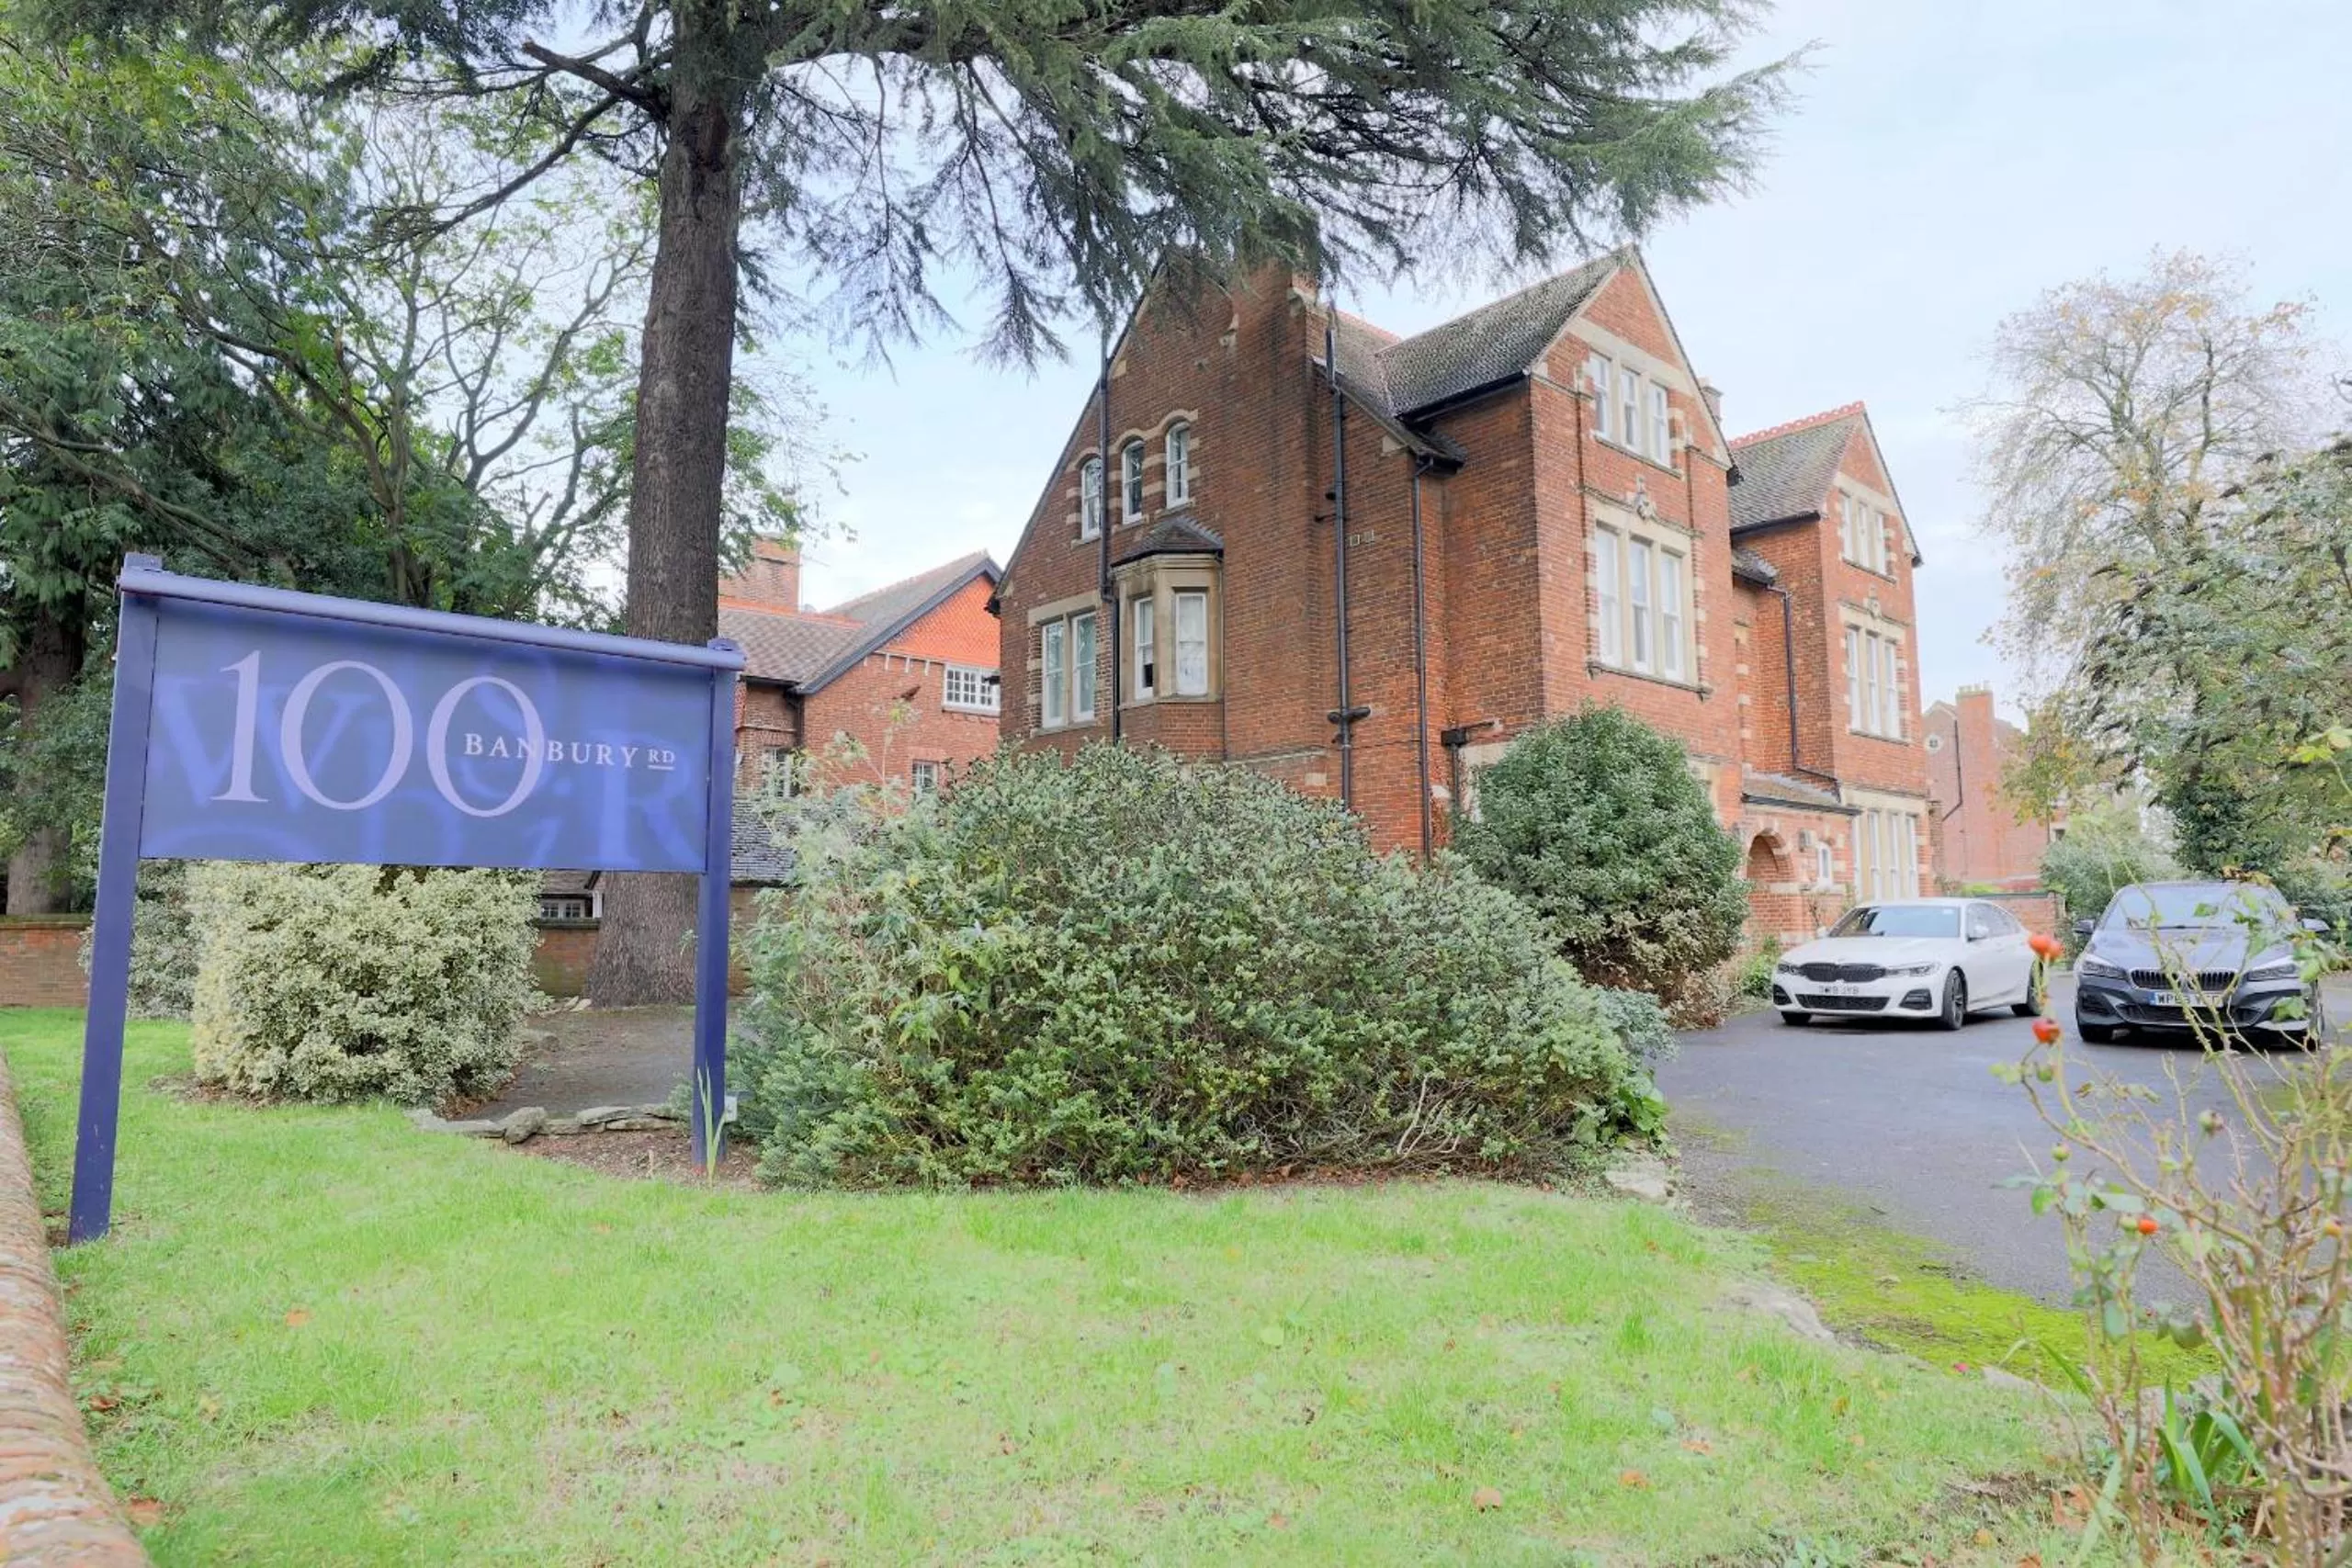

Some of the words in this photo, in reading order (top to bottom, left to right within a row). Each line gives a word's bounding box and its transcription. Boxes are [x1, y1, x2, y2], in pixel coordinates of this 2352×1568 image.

[209, 649, 544, 818] 100
[463, 732, 639, 769] BANBURY
[647, 749, 676, 765] RD
